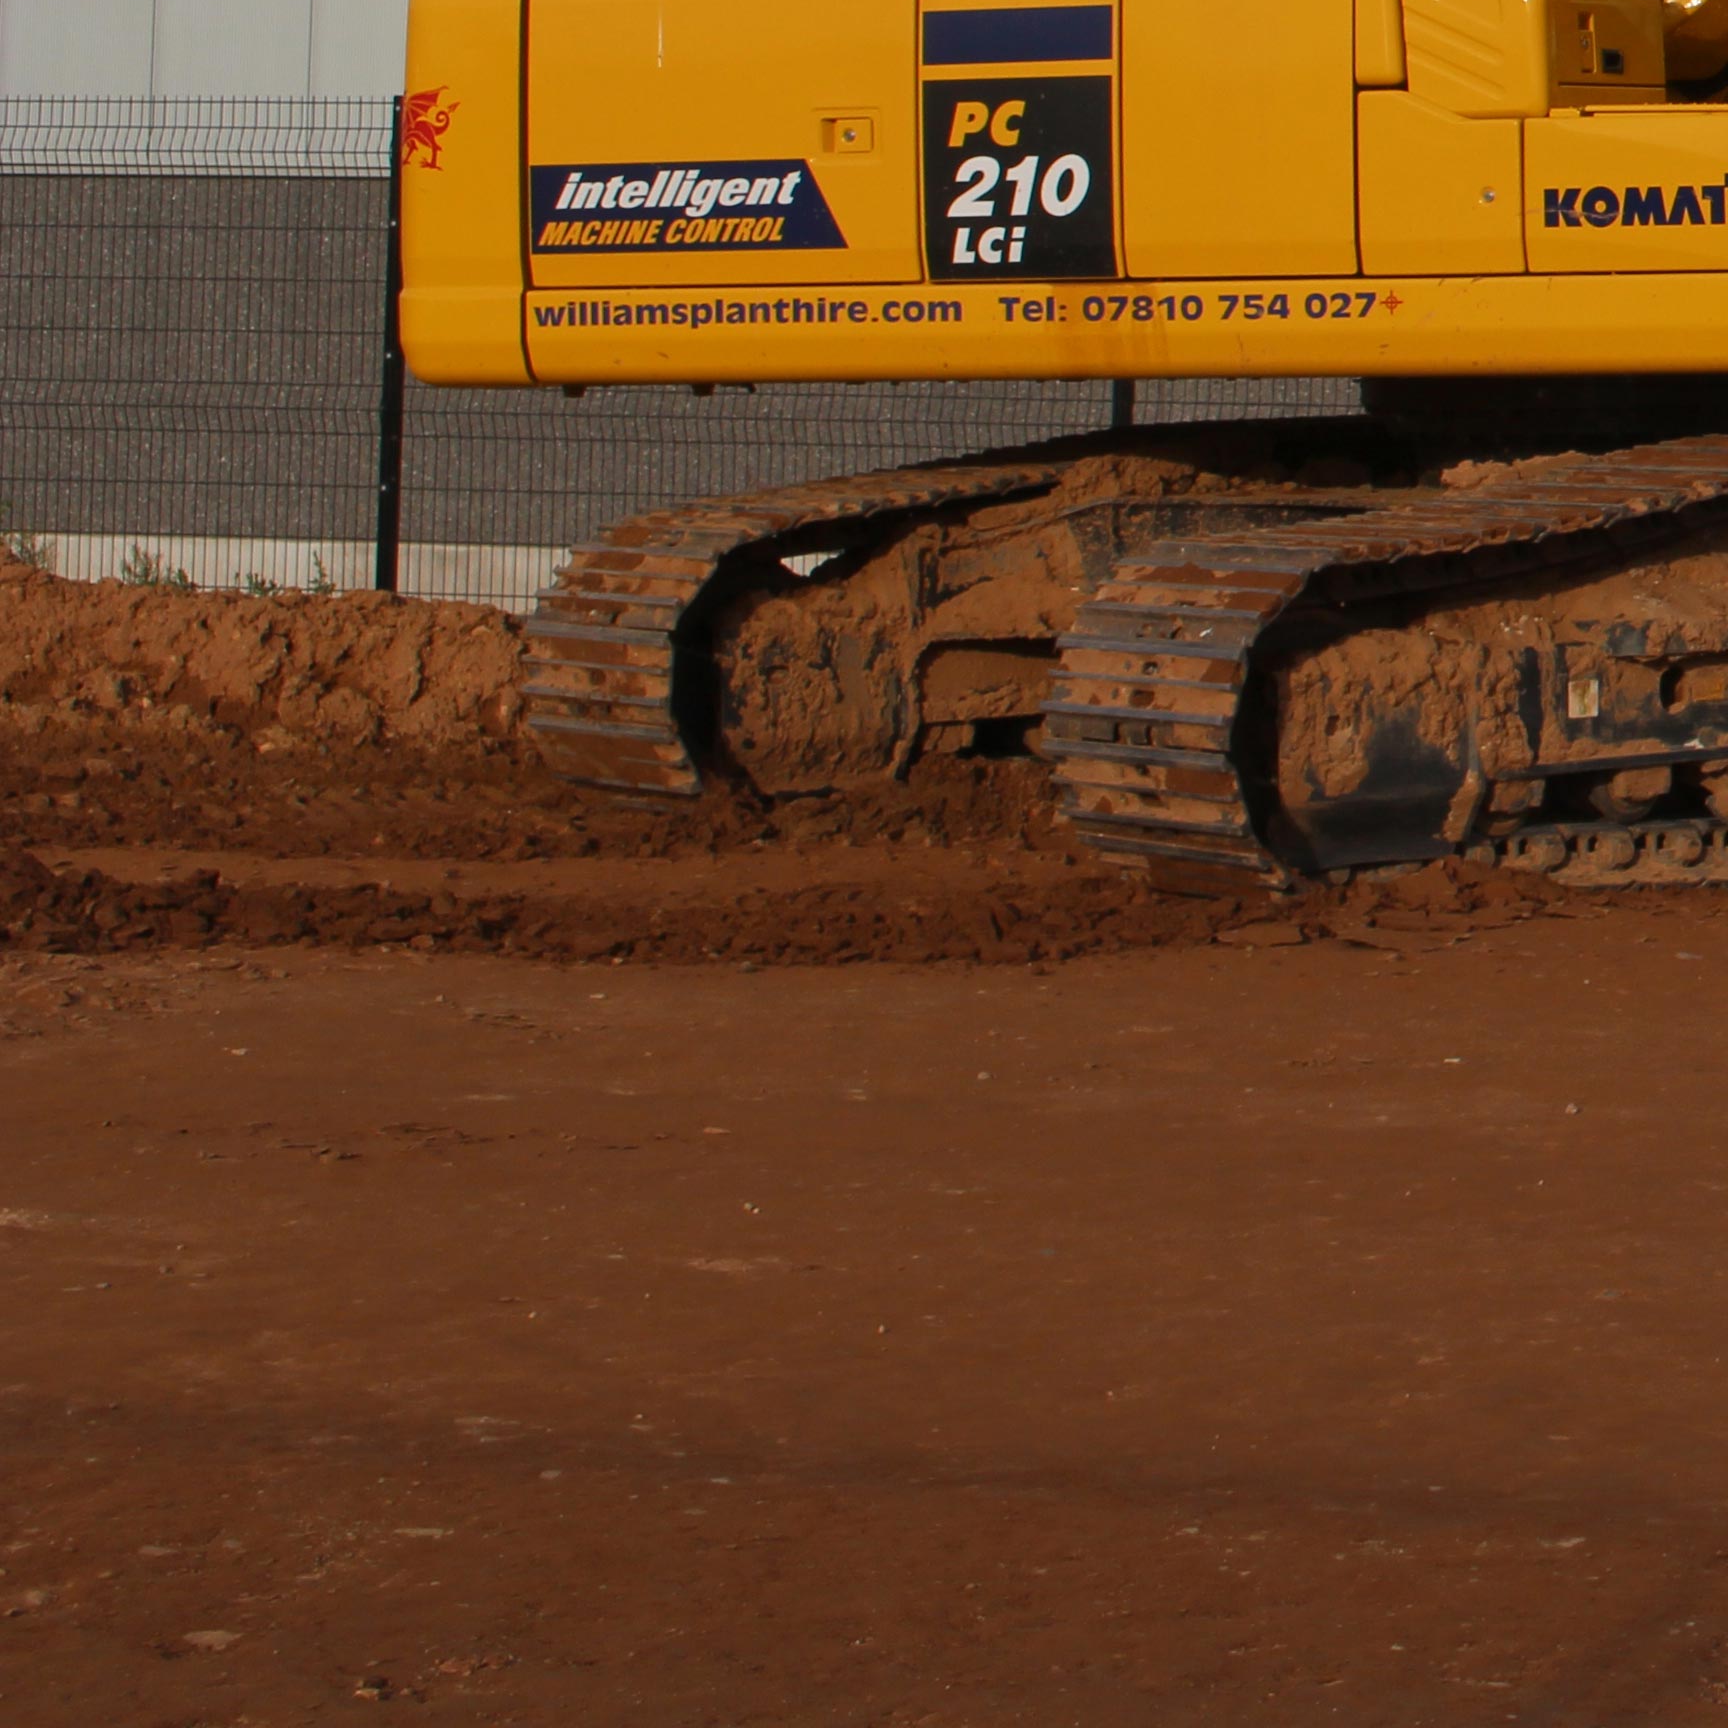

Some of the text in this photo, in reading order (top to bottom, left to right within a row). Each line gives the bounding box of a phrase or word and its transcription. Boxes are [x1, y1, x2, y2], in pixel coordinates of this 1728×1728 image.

[948, 100, 1026, 147] PC
[555, 169, 801, 217] intelligent
[947, 153, 1090, 218] 210
[538, 217, 784, 247] MACHINE CONTROL
[952, 226, 1026, 264] LCi
[534, 292, 1377, 328] williamsplanthire.com Tel: 07810 754 027
